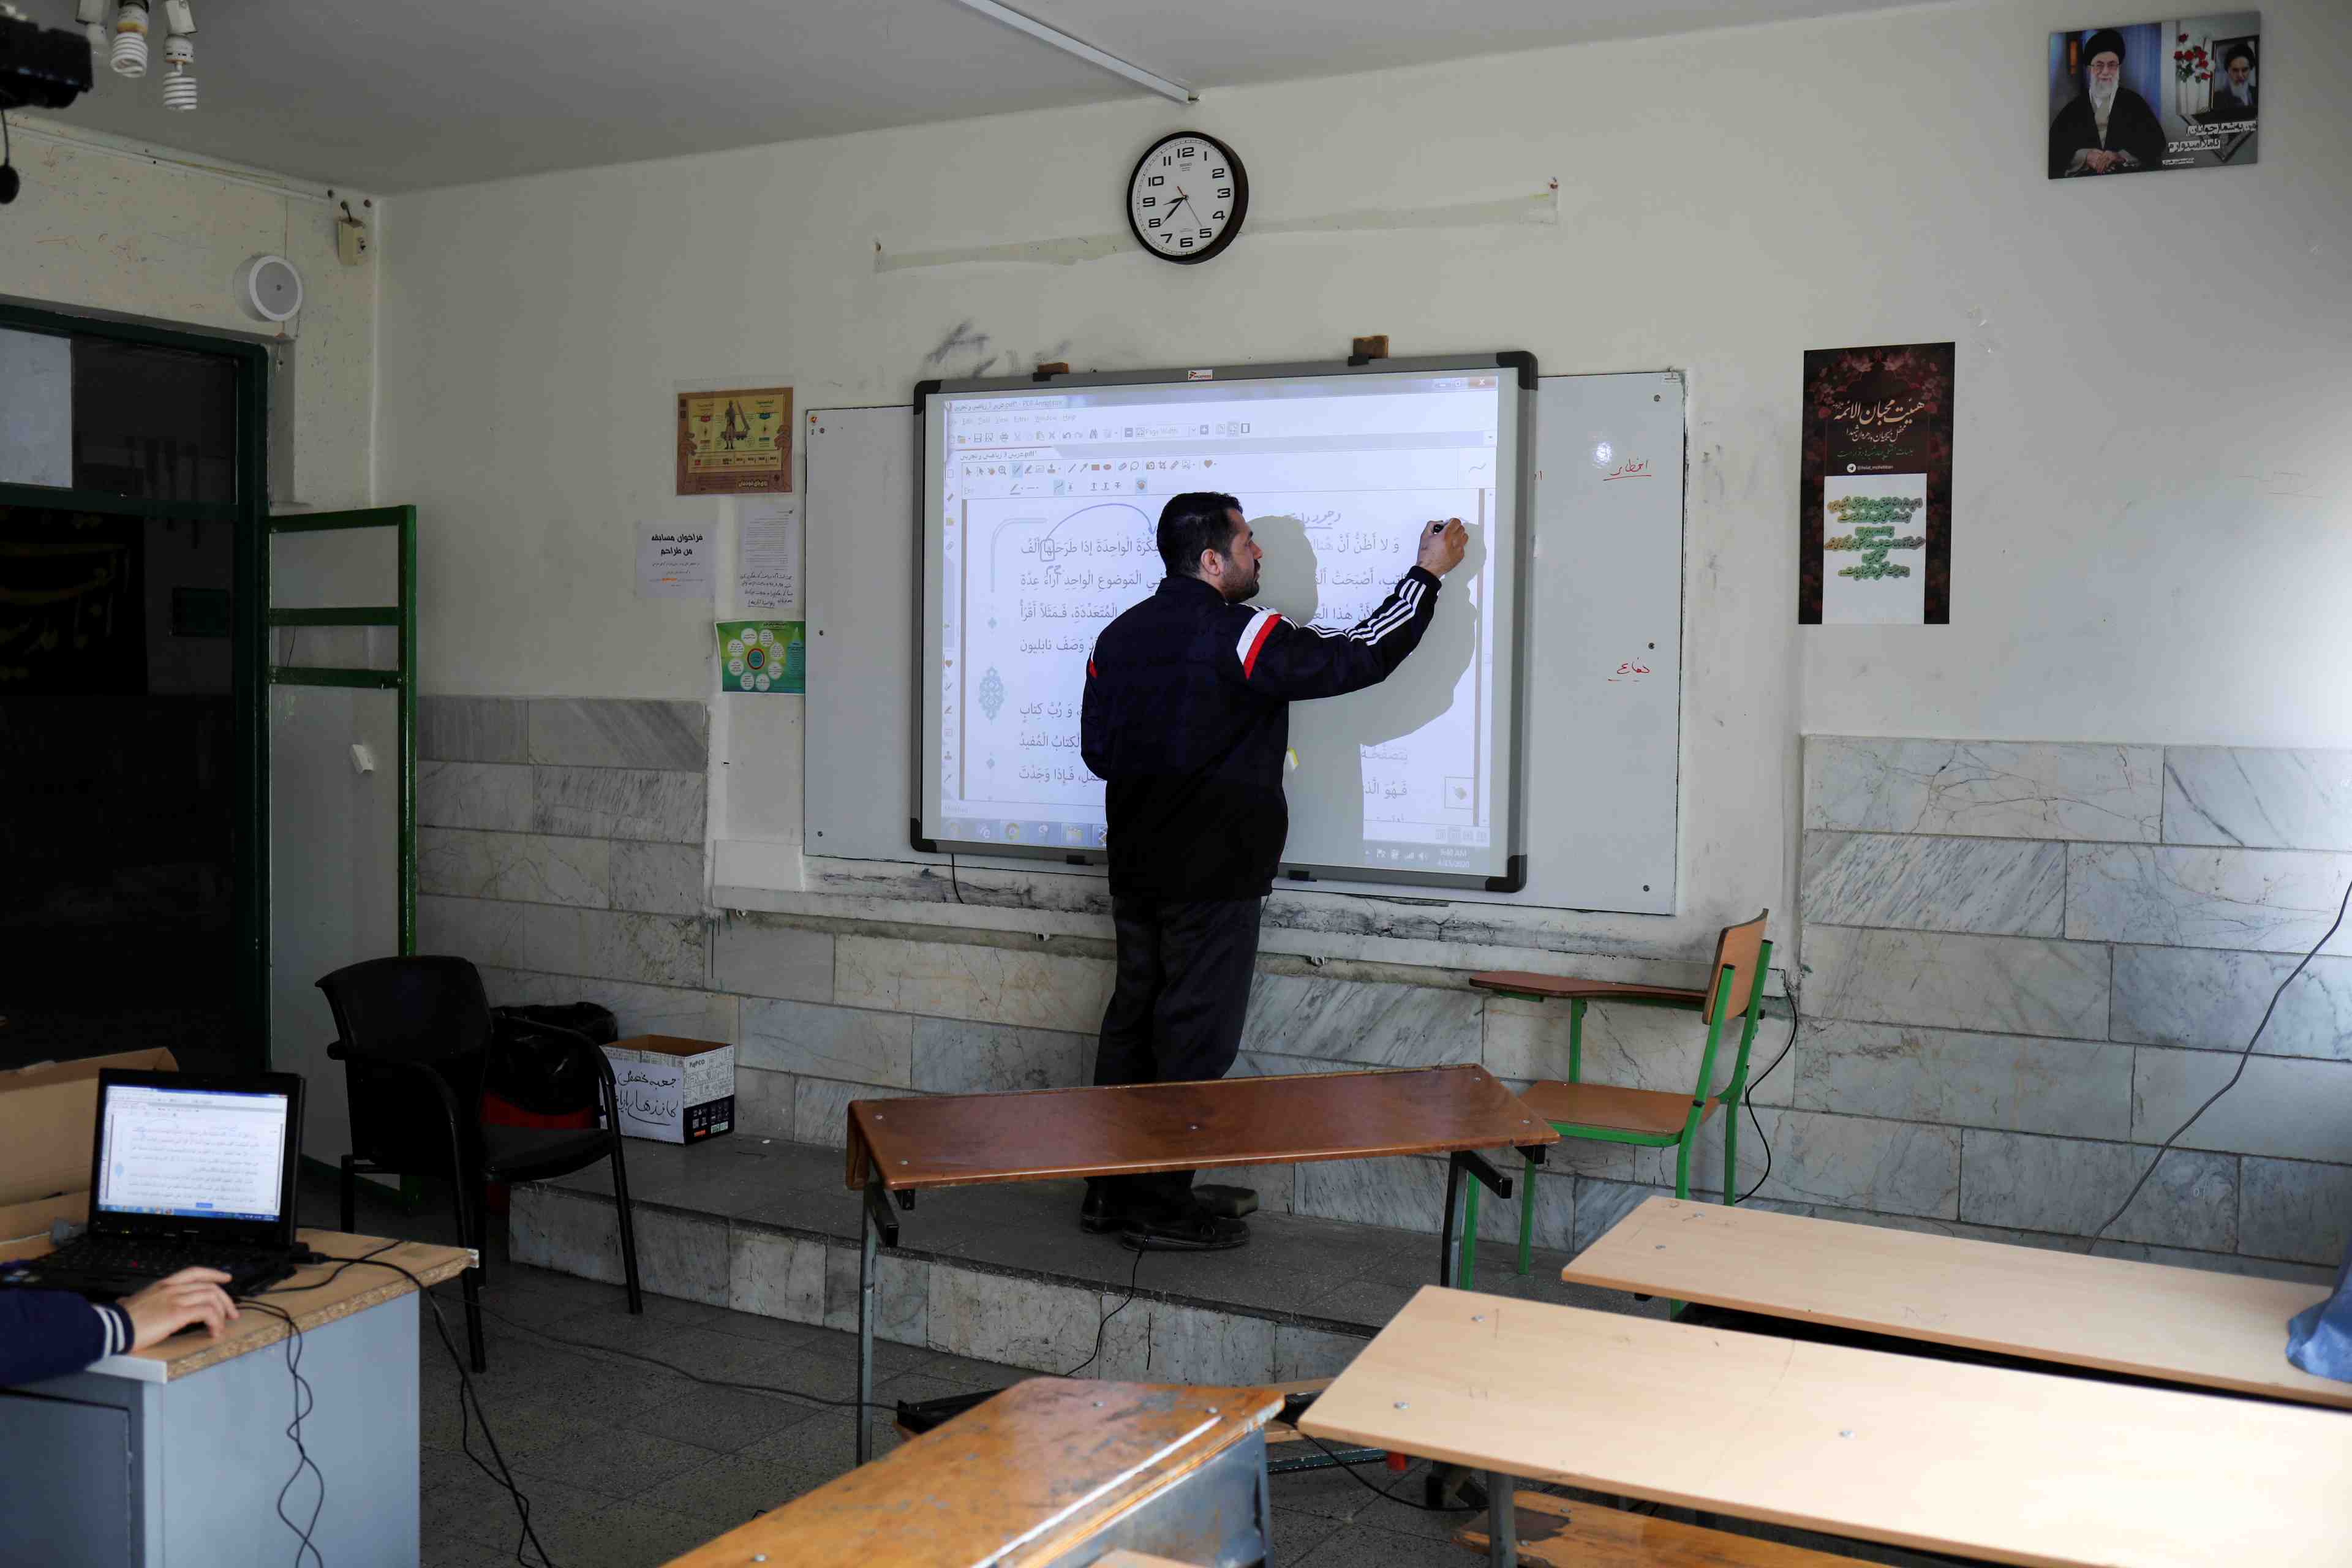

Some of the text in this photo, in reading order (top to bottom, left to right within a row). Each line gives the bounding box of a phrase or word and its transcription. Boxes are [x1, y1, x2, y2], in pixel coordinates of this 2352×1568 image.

[1177, 147, 1194, 158] 12
[1204, 151, 1207, 161] 1
[1163, 156, 1172, 166] 11
[1212, 168, 1224, 179] 2
[1148, 176, 1164, 187] 10
[1217, 187, 1231, 198] 3
[1142, 197, 1156, 208] 9
[1212, 211, 1225, 220] 4
[1148, 218, 1161, 228] 8
[1160, 233, 1172, 243] 7
[1199, 228, 1212, 238] 5
[1180, 238, 1193, 247] 6
[651, 533, 703, 543] فراخوان مسابقه
